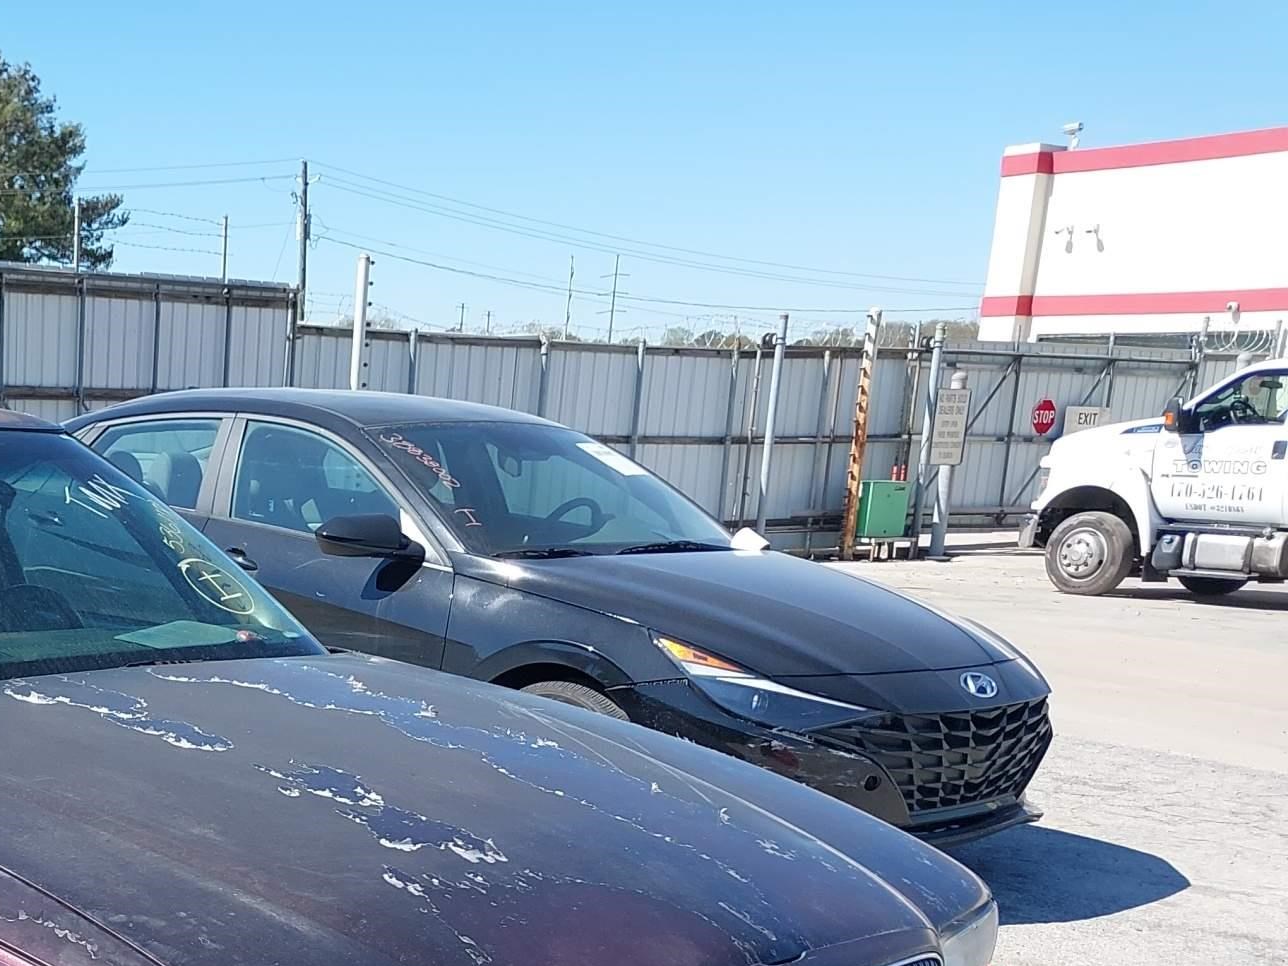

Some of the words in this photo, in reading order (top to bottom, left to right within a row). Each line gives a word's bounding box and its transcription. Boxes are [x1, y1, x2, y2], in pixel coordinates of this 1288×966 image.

[1033, 410, 1055, 424] STOP
[1077, 412, 1098, 425] EXIT
[1172, 459, 1268, 475] TOWING
